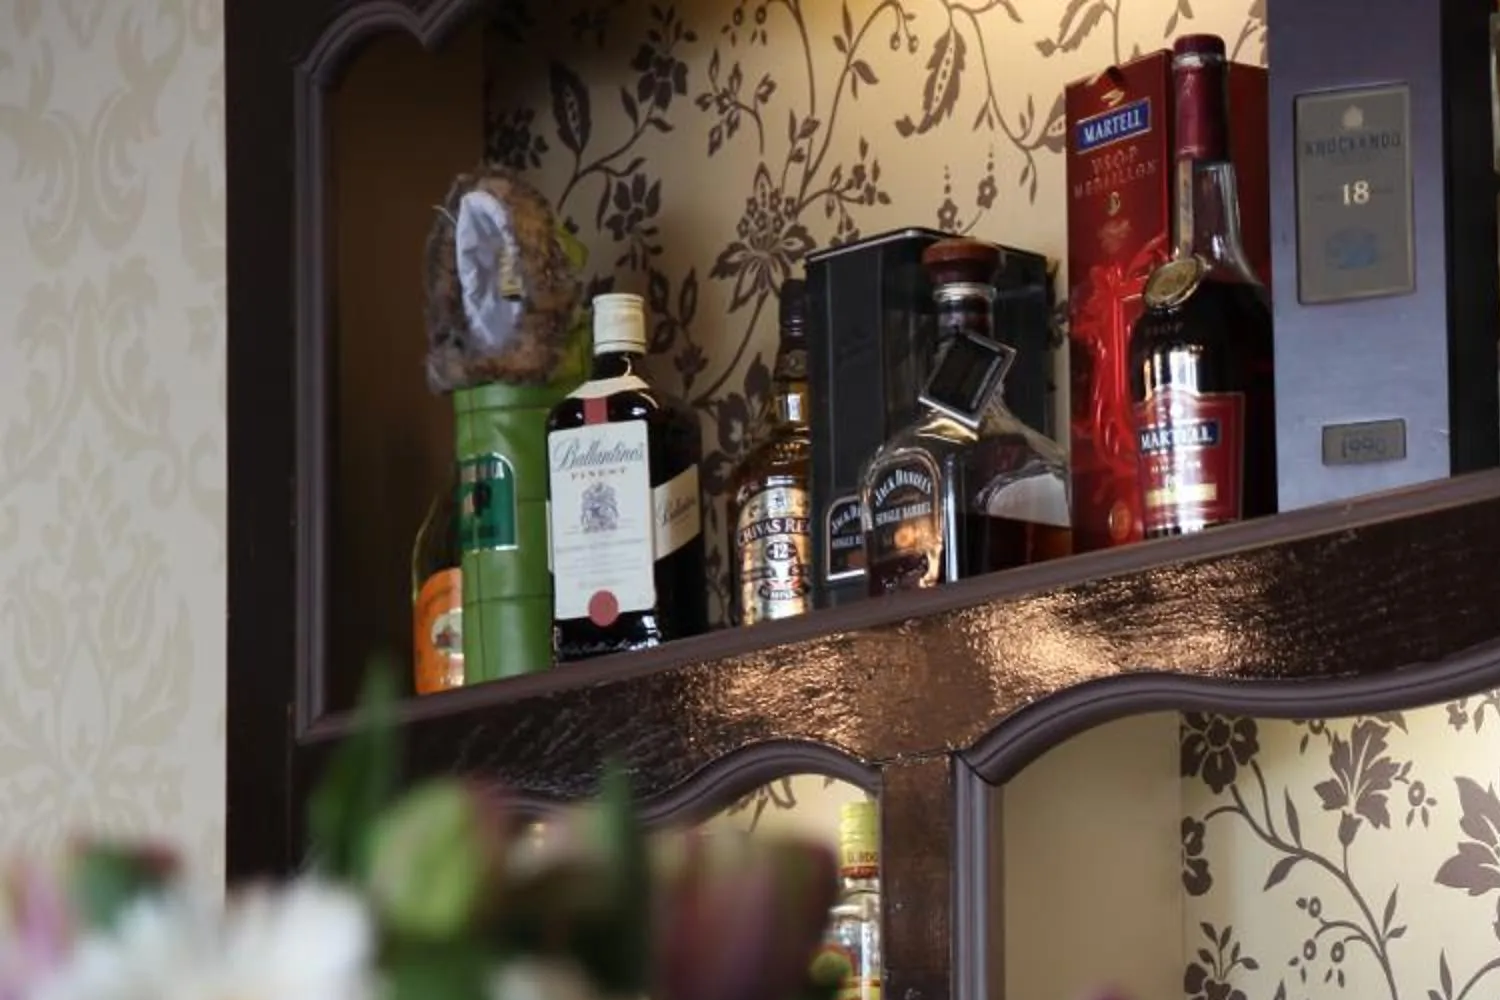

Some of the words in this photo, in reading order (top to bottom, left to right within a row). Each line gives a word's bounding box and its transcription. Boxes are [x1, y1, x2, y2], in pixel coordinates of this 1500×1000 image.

[1084, 109, 1143, 143] MARTELL
[1343, 180, 1371, 206] 18
[738, 517, 781, 547] CHIVAS
